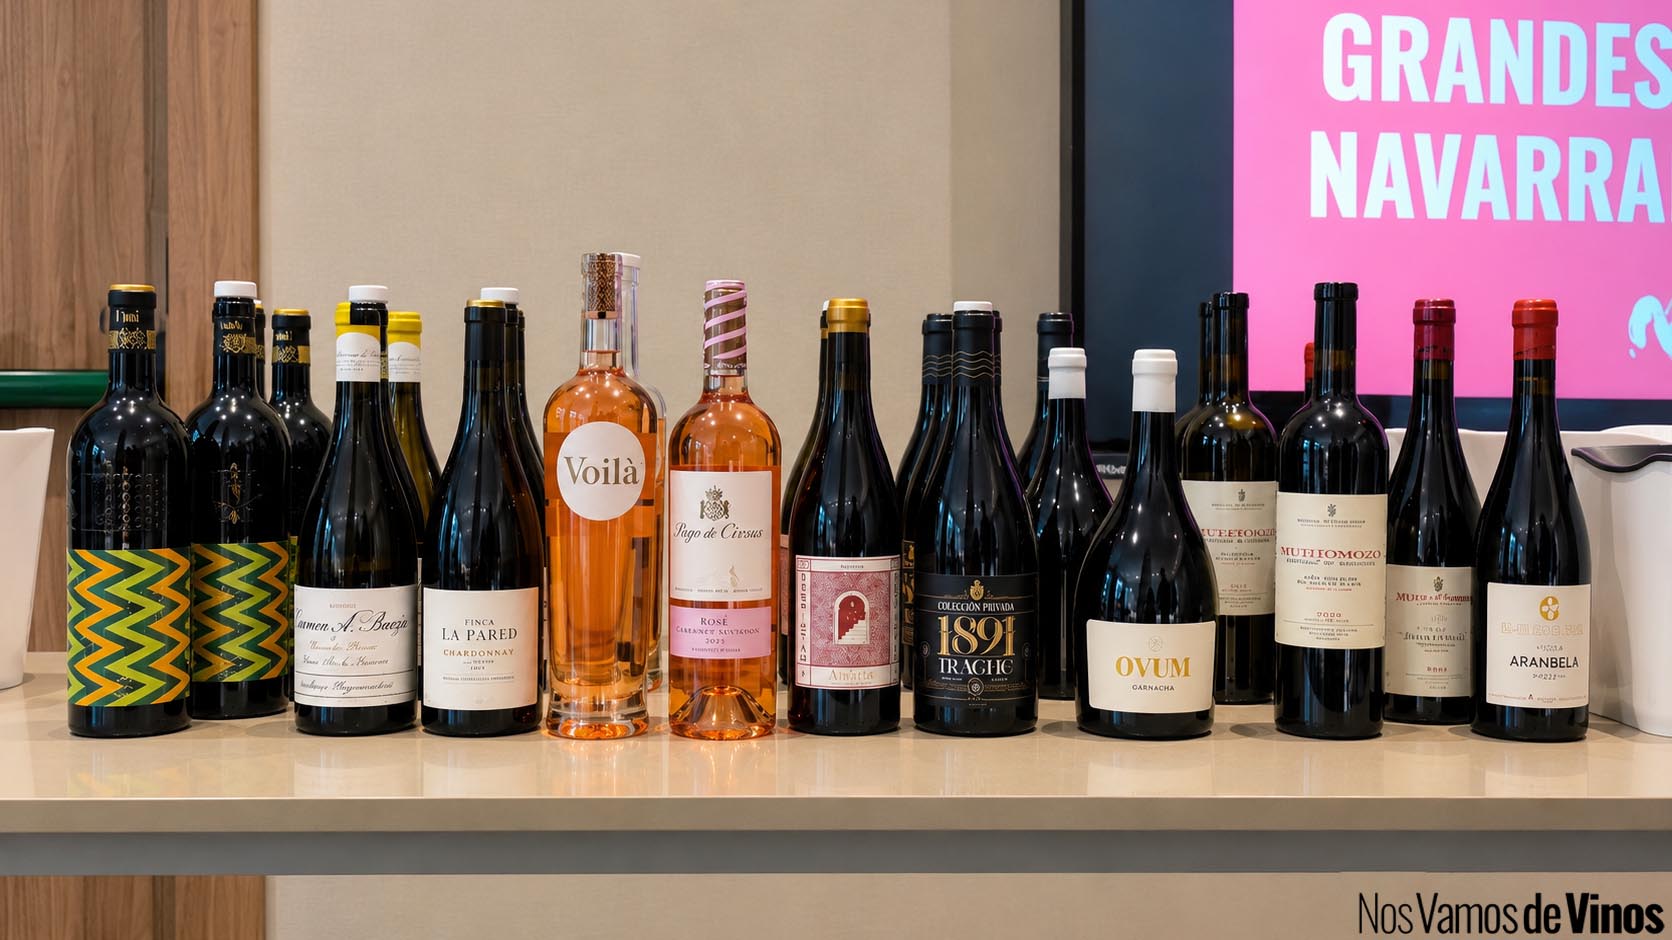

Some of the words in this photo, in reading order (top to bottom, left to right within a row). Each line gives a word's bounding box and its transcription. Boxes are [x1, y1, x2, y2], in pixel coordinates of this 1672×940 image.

[1322, 13, 1672, 109] GRANDES
[1310, 130, 1672, 223] NAVARRA
[563, 456, 640, 485] Voilà
[673, 523, 701, 544] Pago
[703, 524, 717, 539] de
[442, 627, 460, 641] LA
[466, 627, 518, 641] PARED
[937, 615, 1016, 656] 1891
[443, 649, 514, 657] CHARDONNAY
[1510, 655, 1579, 669] ARANBELA
[1115, 656, 1192, 679] OVUM
